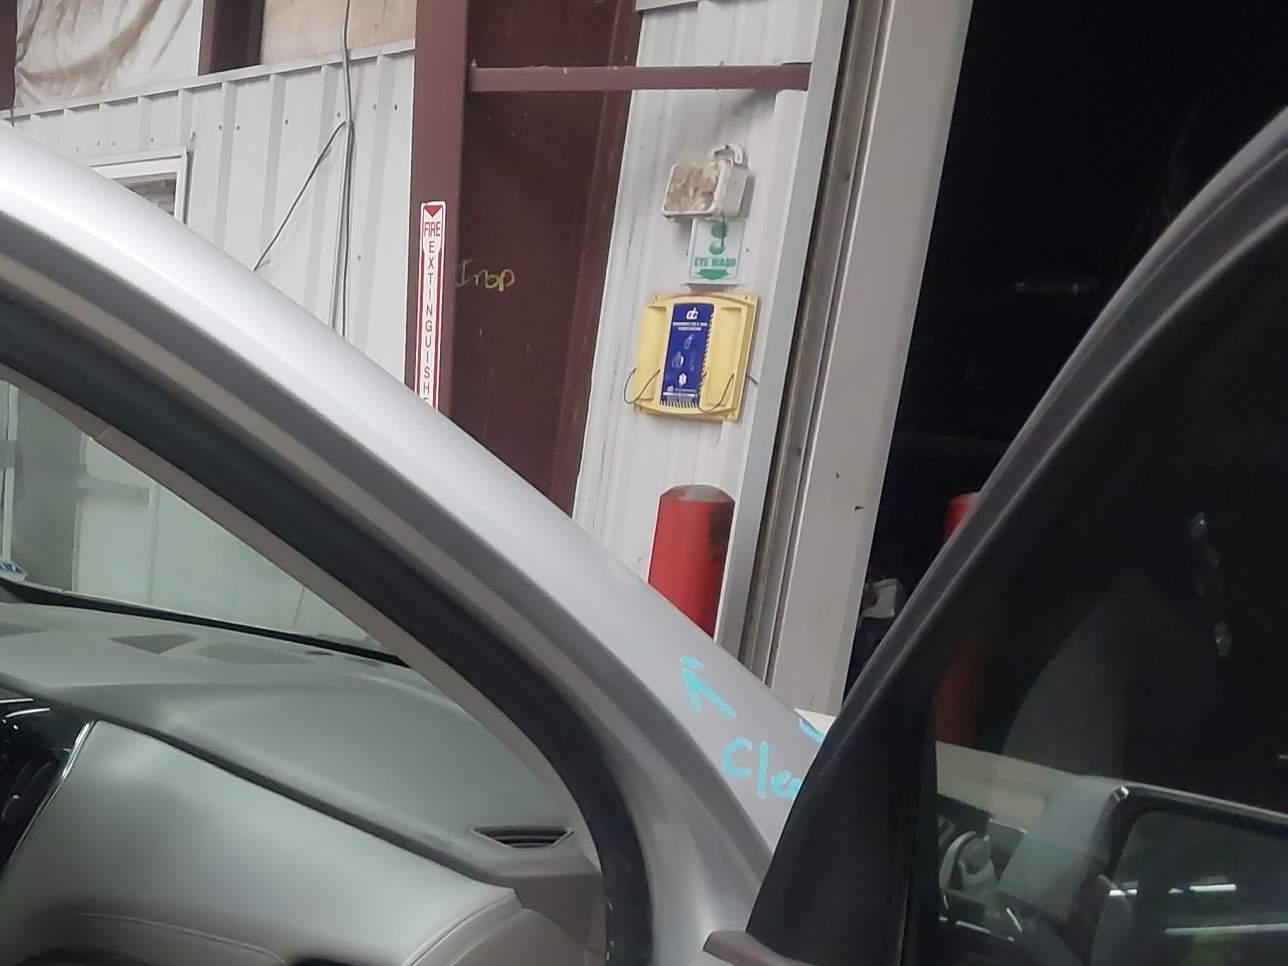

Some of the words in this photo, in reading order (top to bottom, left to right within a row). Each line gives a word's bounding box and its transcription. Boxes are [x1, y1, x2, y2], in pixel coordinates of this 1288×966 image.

[423, 221, 441, 237] FIRE
[694, 257, 709, 267] EYE
[711, 257, 736, 268] WASH
[456, 259, 516, 292] Inop
[422, 240, 436, 401] EXTINGUISH
